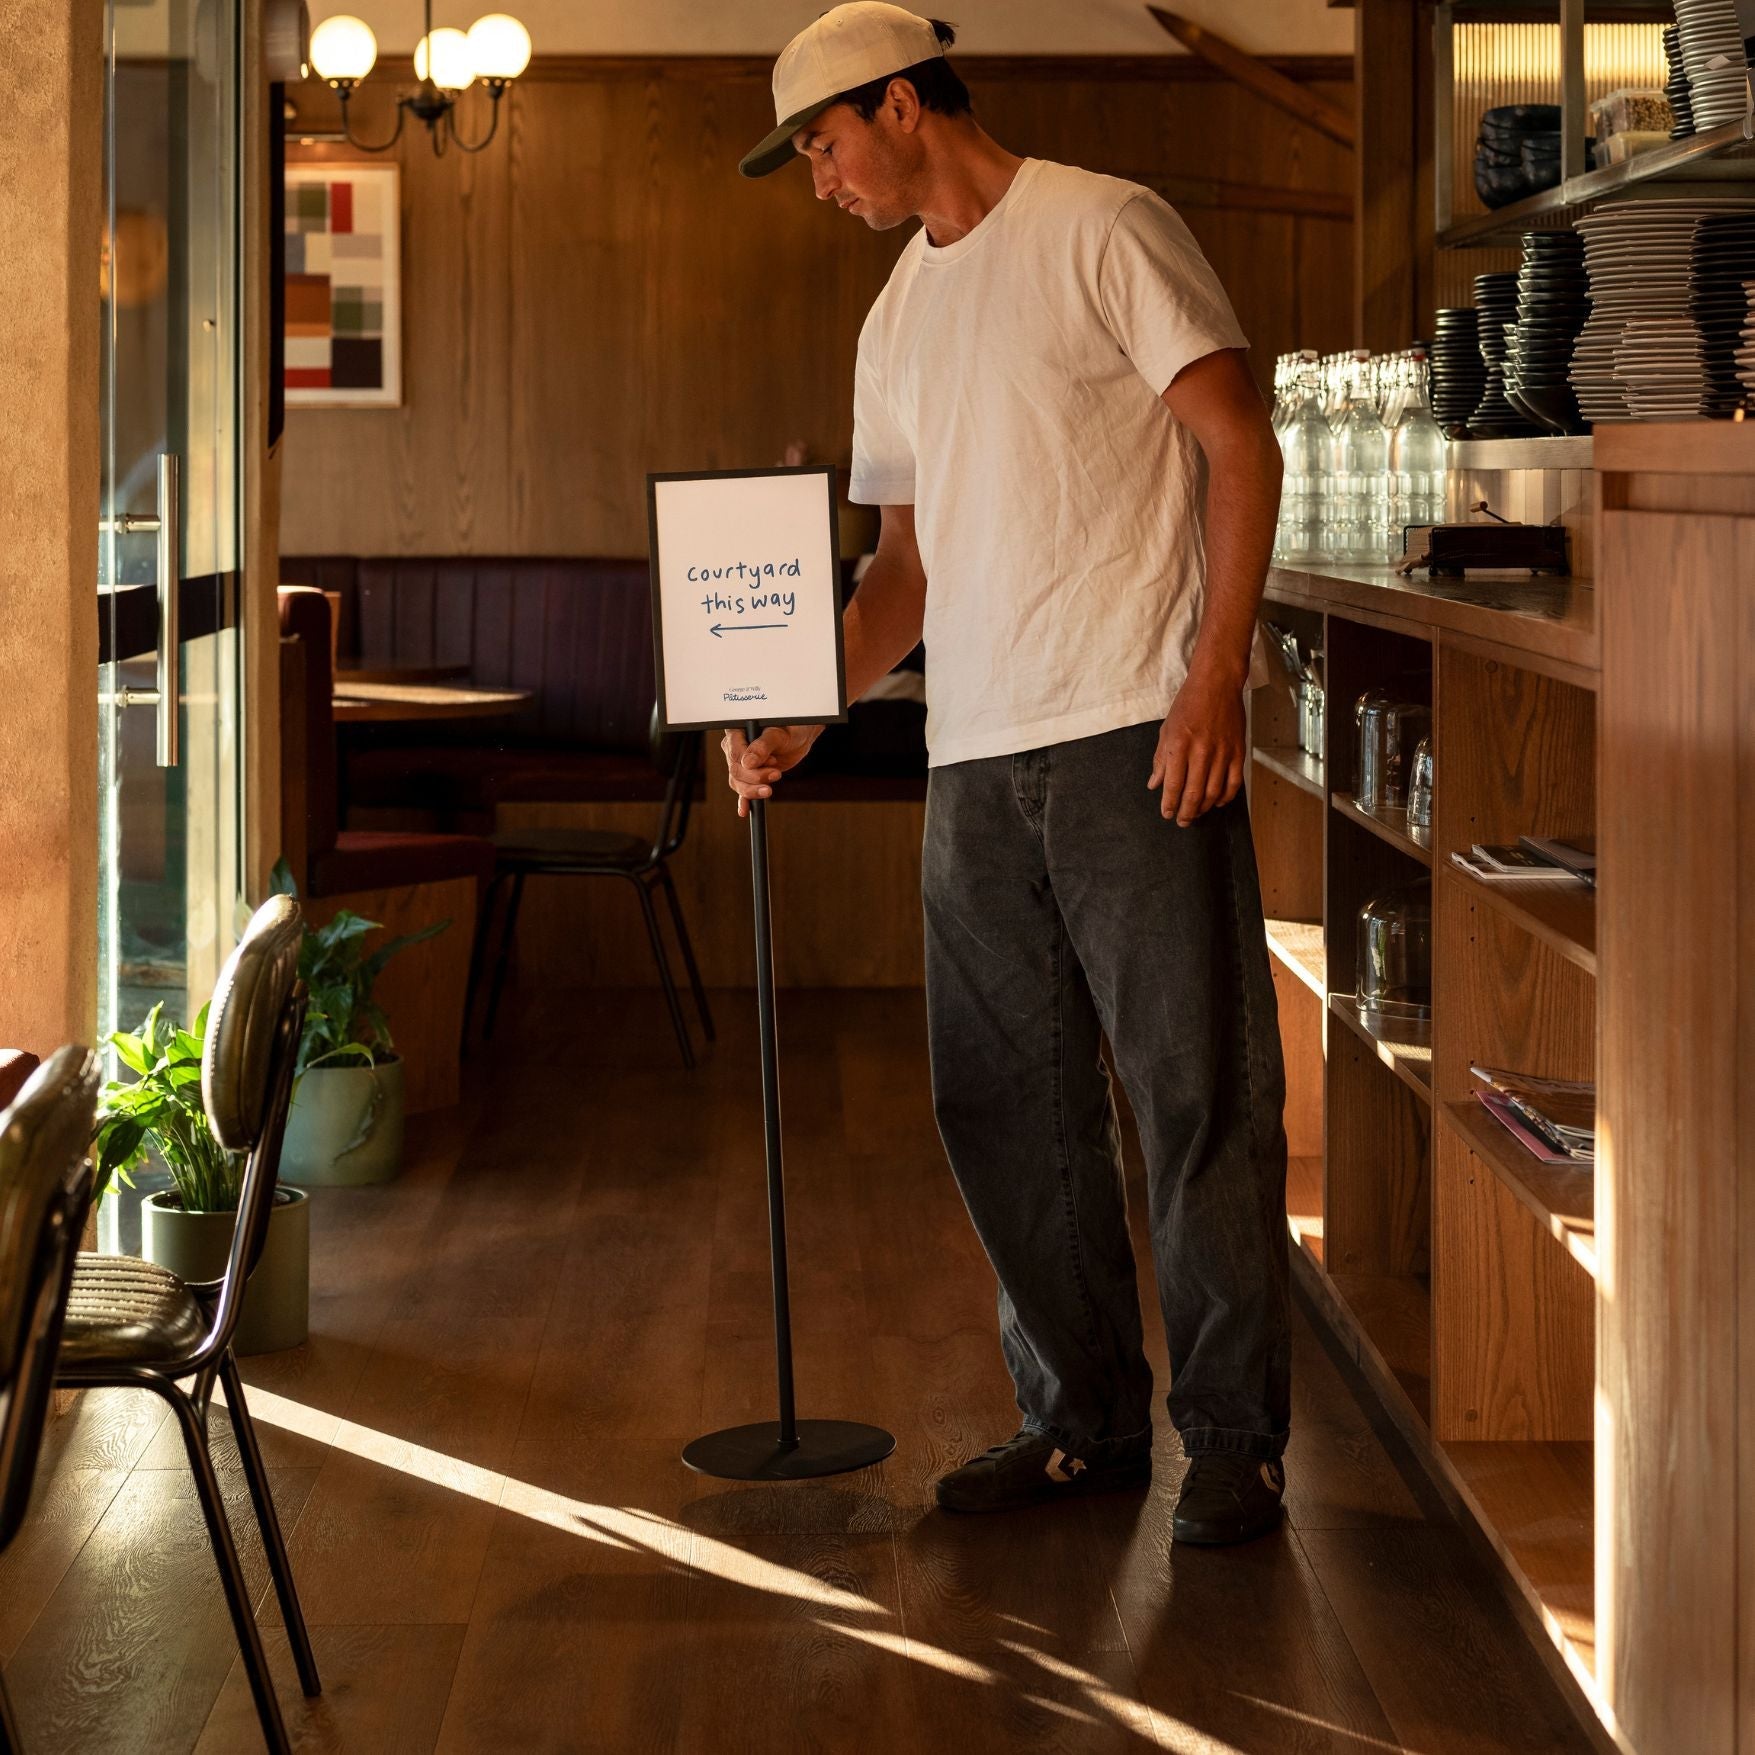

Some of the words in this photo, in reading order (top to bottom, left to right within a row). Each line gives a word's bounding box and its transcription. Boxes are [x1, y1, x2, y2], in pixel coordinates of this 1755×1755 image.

[687, 558, 801, 590] courtyard
[700, 592, 745, 615] this
[750, 590, 796, 616] way
